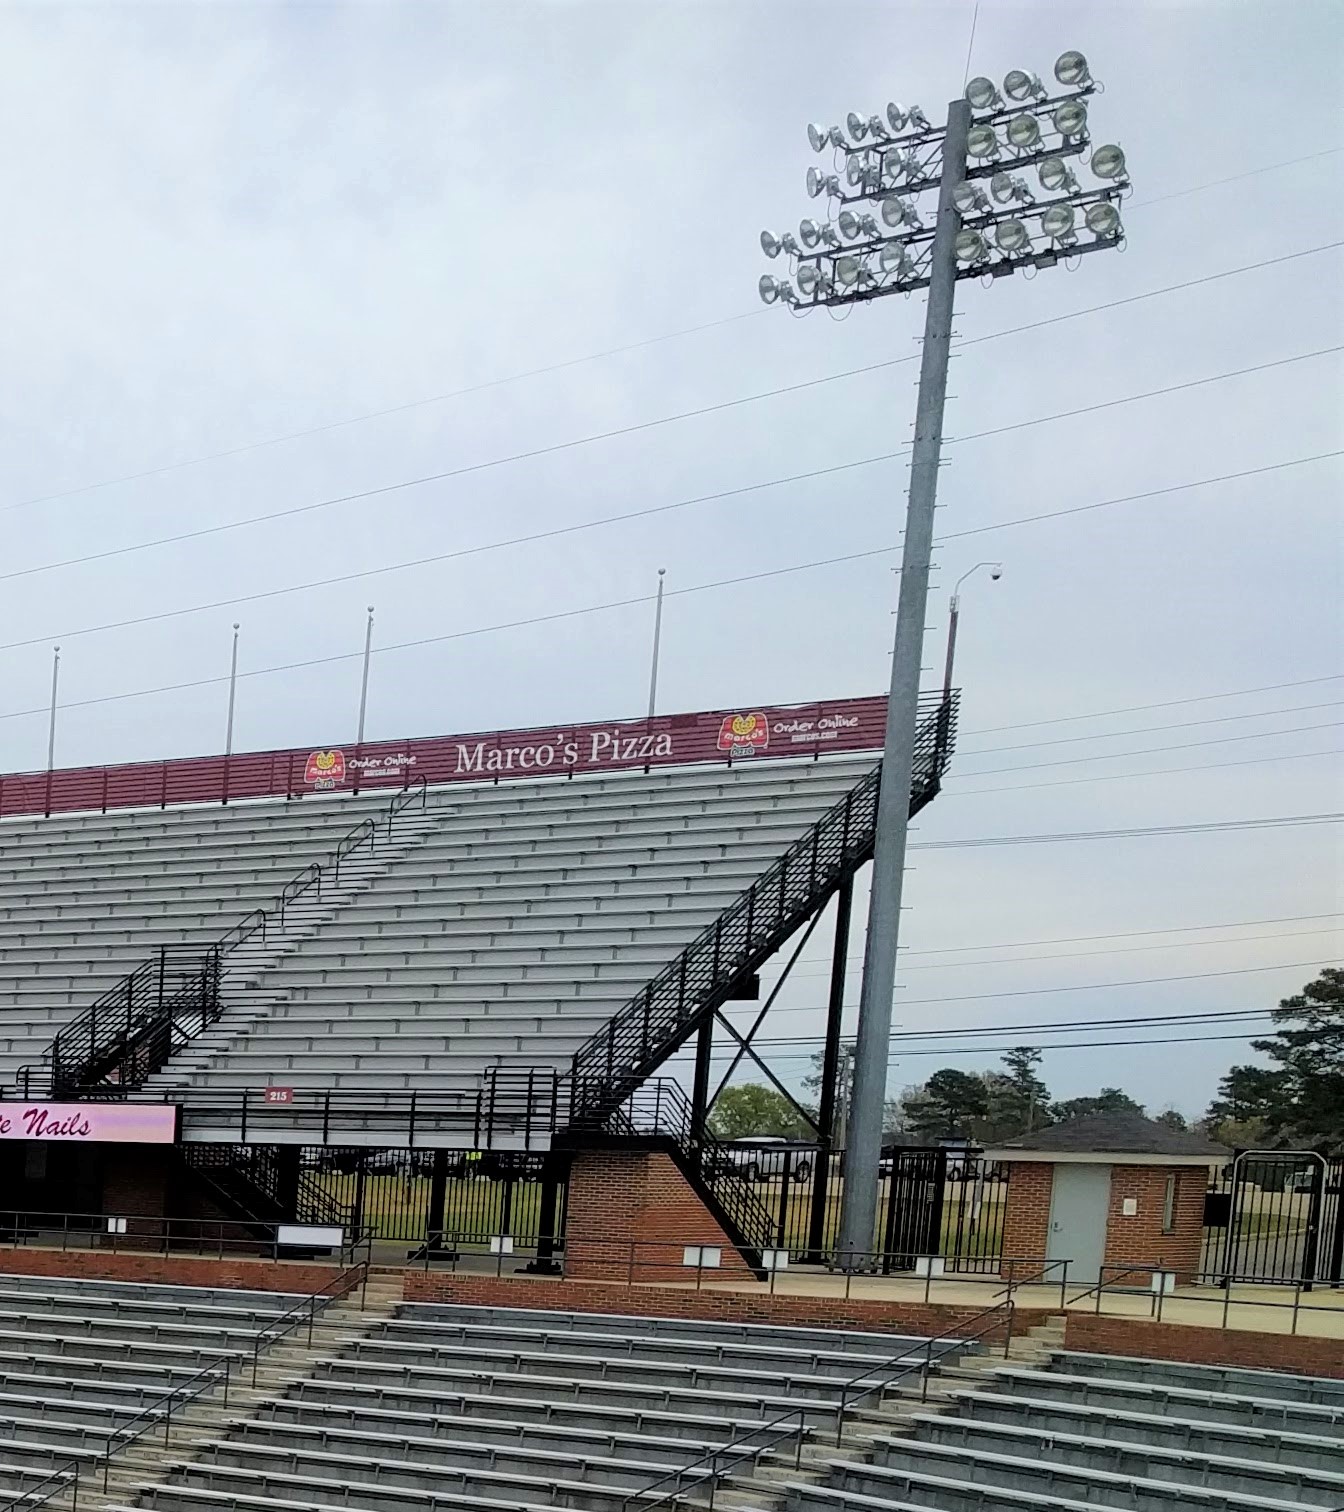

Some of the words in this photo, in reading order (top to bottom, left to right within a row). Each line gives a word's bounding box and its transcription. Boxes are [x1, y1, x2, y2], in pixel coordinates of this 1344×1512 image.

[773, 720, 814, 733] Order
[818, 715, 859, 730] Online
[454, 733, 578, 774] Marco's
[588, 729, 673, 763] Pizza
[348, 756, 381, 769] Order
[383, 753, 417, 767] Online
[269, 1091, 288, 1101] 215
[22, 1108, 92, 1137] Nails
